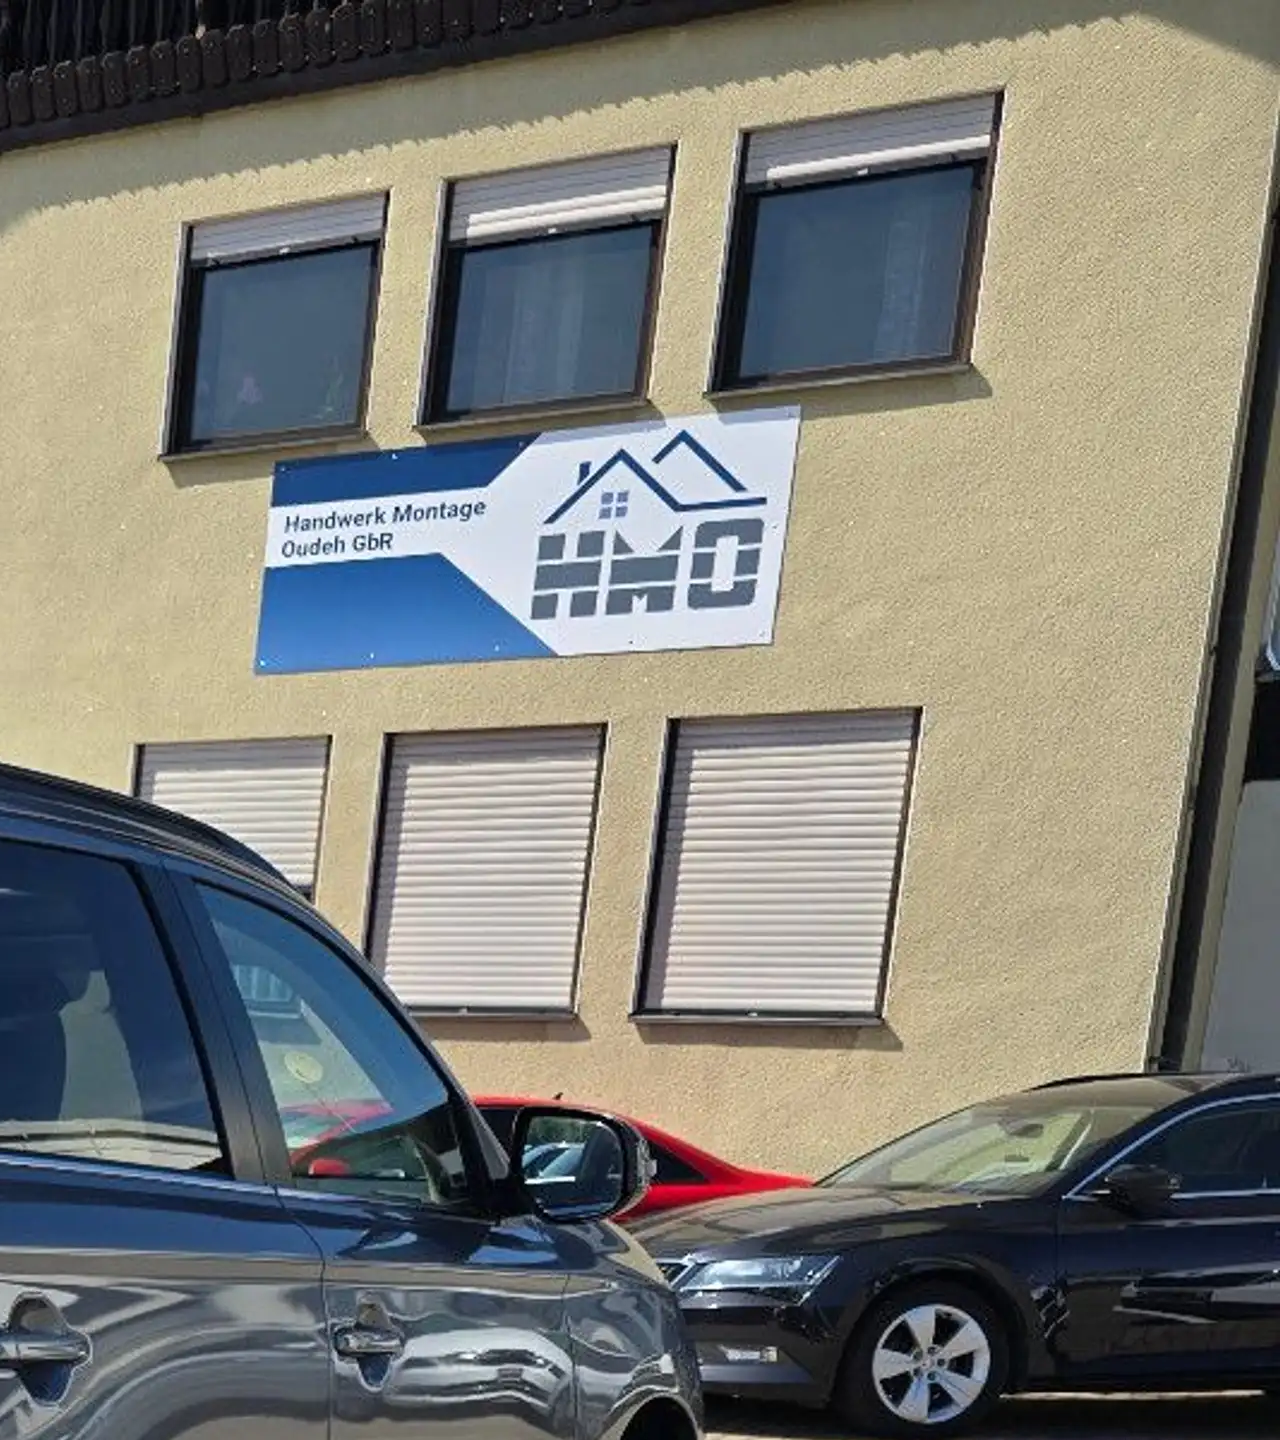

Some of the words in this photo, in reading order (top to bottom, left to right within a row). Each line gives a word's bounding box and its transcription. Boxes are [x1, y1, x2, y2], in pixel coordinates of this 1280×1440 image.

[284, 506, 386, 533] Handwerk
[392, 501, 487, 523] Montage
[281, 535, 346, 558] Oudeh
[352, 532, 394, 551] GbR
[531, 518, 765, 620] HMO
